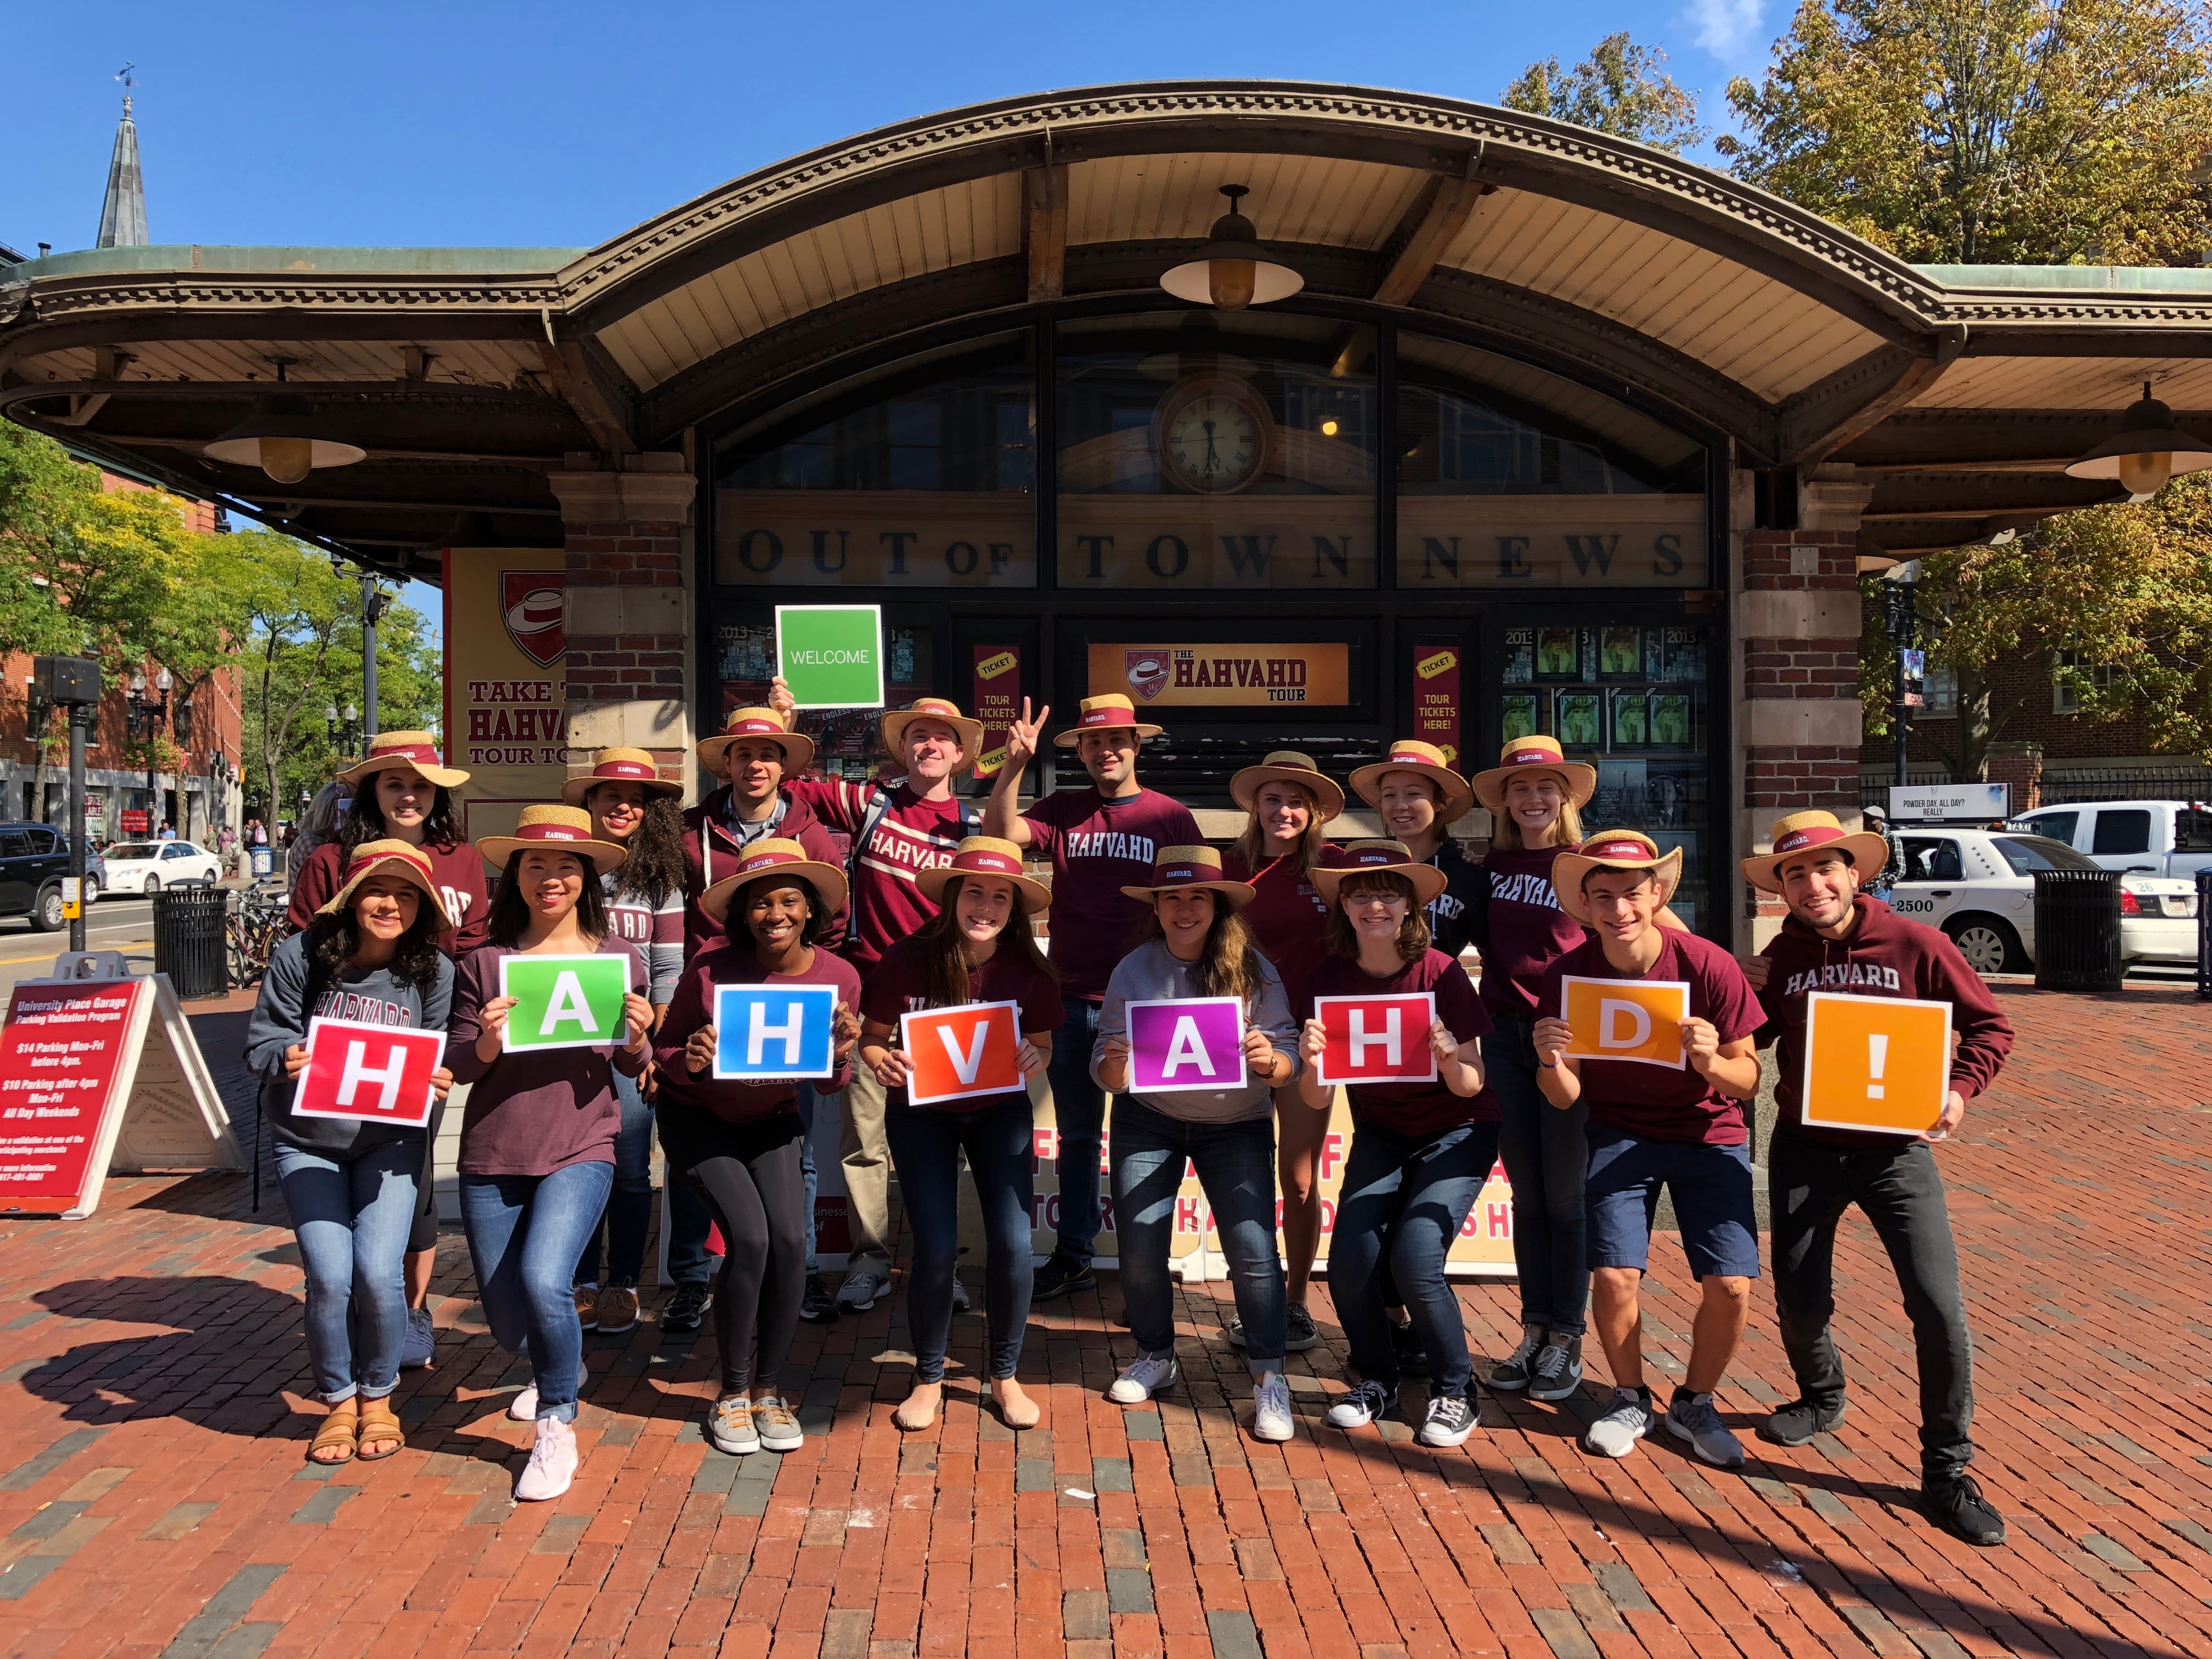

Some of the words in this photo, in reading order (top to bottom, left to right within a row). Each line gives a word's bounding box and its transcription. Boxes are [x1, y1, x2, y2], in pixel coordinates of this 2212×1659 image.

[738, 529, 917, 574] OUT
[945, 541, 1013, 575] OF
[1077, 534, 1351, 579] TOWN
[1421, 534, 1683, 578] NEWS
[791, 650, 870, 665] WELCOME
[1173, 650, 1194, 658] THE
[981, 657, 1010, 674] TICKET
[1421, 656, 1449, 673] TICKET
[1174, 659, 1306, 687] HAHVAHD
[468, 681, 552, 703] TAKE
[1267, 689, 1306, 701] TOUR
[984, 695, 1010, 705] TOUR
[1424, 694, 1450, 704] TOUR
[979, 708, 1015, 718] TICKETS
[1085, 714, 1105, 723] HARVARD
[1419, 707, 1456, 717] TICKETS
[1424, 719, 1451, 730] HERE!
[469, 748, 535, 765] TOUR
[981, 752, 1007, 768] TICKE
[1517, 754, 1543, 762] HARVARD
[617, 766, 641, 774] HARVARD
[1903, 799, 1925, 808] POWDER
[1926, 799, 1938, 808] DAY,
[1939, 799, 1949, 807] ALL
[85, 807, 101, 816] LABLE
[1923, 808, 1944, 816] REALLY.
[2009, 822, 2031, 831] TAXI
[545, 831, 573, 840] HARVARD
[1066, 832, 1153, 865] HAHVAHD
[1782, 835, 1809, 850] HARVARD
[868, 830, 954, 870] HARVAR
[746, 859, 774, 870] HARVARD
[978, 858, 1005, 868] HARVARD
[2136, 882, 2154, 893] 26
[1891, 900, 1934, 912] -2500
[1784, 963, 1900, 996] HARVARD
[18, 1000, 63, 1013] University
[64, 998, 91, 1011] Place
[93, 997, 127, 1009] Garage
[539, 970, 599, 1035] A
[15, 1014, 46, 1025] Parking
[47, 1013, 86, 1024] Validation
[87, 1012, 121, 1023] Program
[1599, 998, 1651, 1048] D
[747, 1002, 803, 1064] H
[1348, 1008, 1402, 1067] H
[16, 1043, 35, 1054] $14
[35, 1041, 69, 1054] Parking
[70, 1040, 105, 1052] Mon-Fri
[936, 1020, 989, 1085] V
[1161, 1015, 1216, 1077] A
[30, 1056, 59, 1067] before
[60, 1056, 82, 1068] 4pm.
[1866, 1034, 1888, 1099] !
[336, 1040, 408, 1110] H
[2, 1080, 21, 1091] $10
[21, 1079, 54, 1091] Parking
[55, 1078, 78, 1089] after
[79, 1077, 99, 1090] 4pm
[28, 1092, 64, 1104] Mon-Fri
[4, 1108, 17, 1118] All
[17, 1107, 35, 1120] Day
[35, 1106, 80, 1118] Weekends
[13, 1136, 44, 1144] validation
[33, 1146, 67, 1154] merchants
[20, 1164, 57, 1172] information
